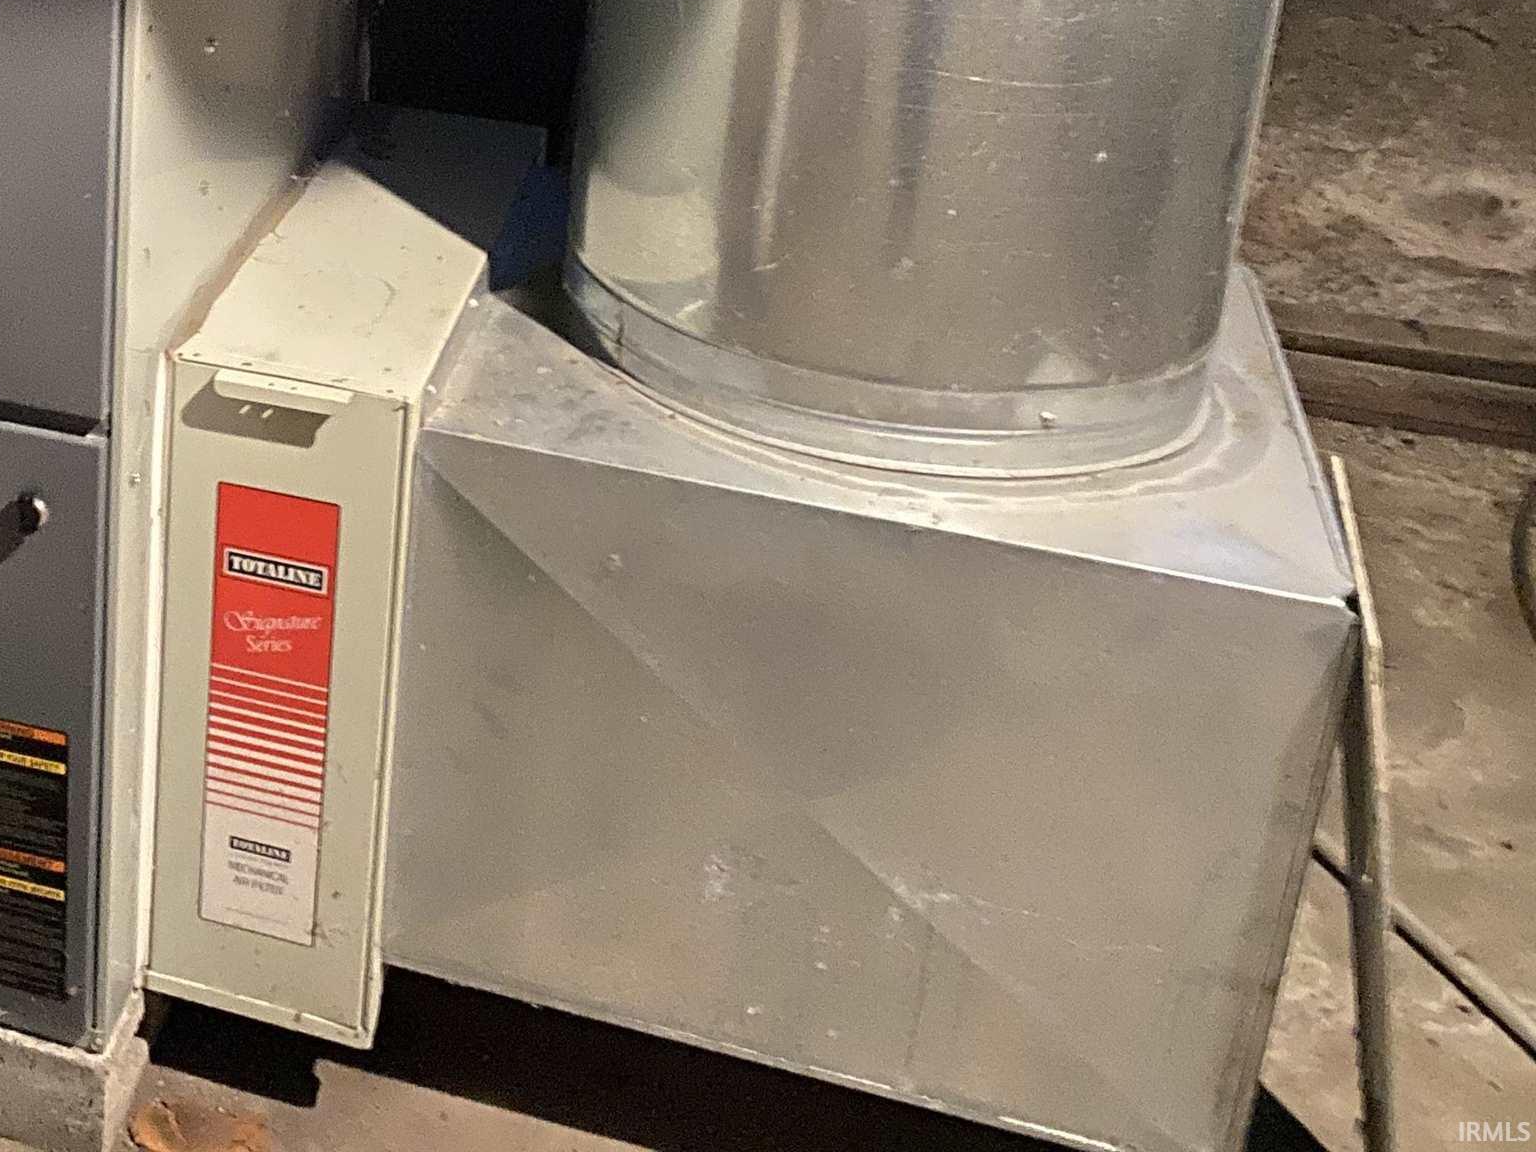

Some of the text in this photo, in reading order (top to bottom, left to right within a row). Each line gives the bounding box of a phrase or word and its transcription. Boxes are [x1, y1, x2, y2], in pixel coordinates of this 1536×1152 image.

[229, 554, 322, 588] TOTALINE
[224, 610, 323, 635] Signature
[246, 634, 293, 653] Series
